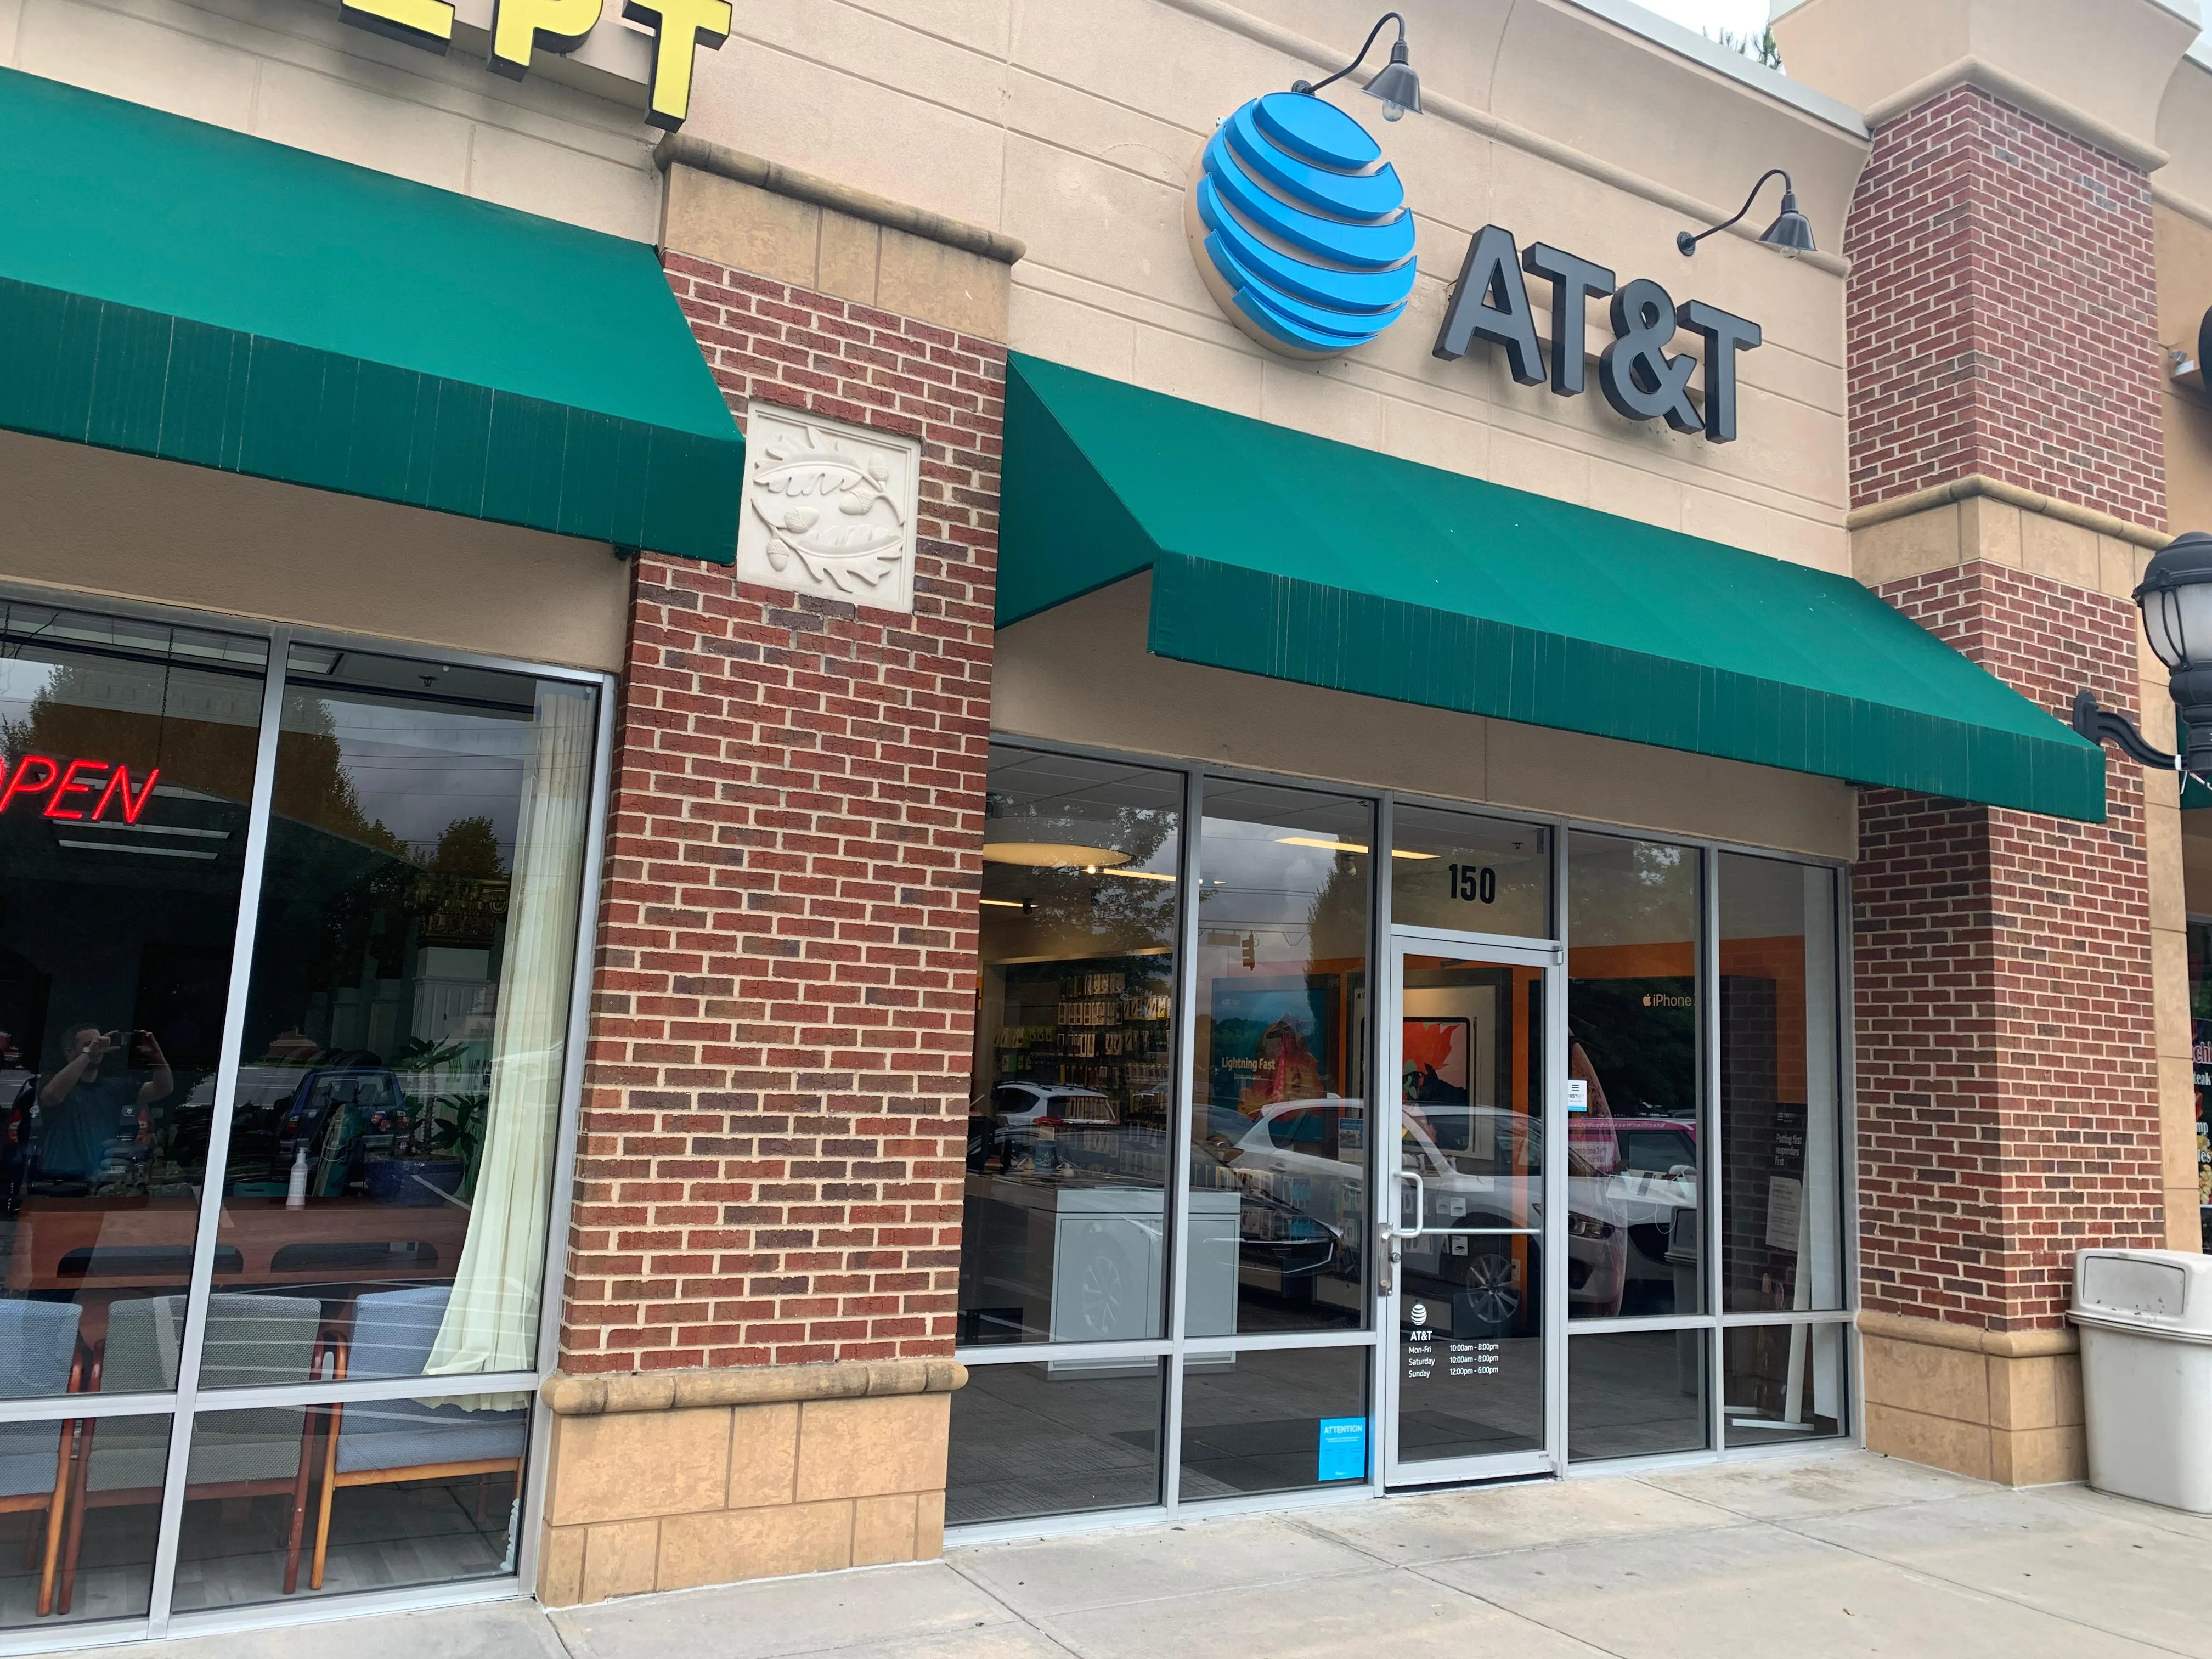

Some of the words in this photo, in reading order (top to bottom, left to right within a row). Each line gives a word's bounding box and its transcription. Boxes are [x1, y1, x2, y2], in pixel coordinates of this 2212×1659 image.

[338, 0, 732, 133] PT
[1432, 224, 1762, 444] AT&T
[0, 755, 160, 823] PEN
[1448, 864, 1496, 904] 150
[1652, 994, 1692, 1006] iPhone
[1222, 1057, 1257, 1071] Lightning
[1259, 1058, 1276, 1070] Fast
[2193, 1072, 2212, 1086] teak
[2196, 1122, 2209, 1135] mp
[1776, 1133, 1792, 1146] Putting
[1792, 1135, 1803, 1145] first
[1775, 1147, 1800, 1156] responders
[2197, 1149, 2211, 1163] les
[1774, 1156, 1785, 1166] first
[1410, 1331, 1432, 1341] AT&T
[1409, 1346, 1432, 1354] Mon-Fri
[1478, 1343, 1499, 1352] 8:00pm
[1409, 1358, 1435, 1367] Saturday
[1478, 1355, 1499, 1363] 8:00pm
[1409, 1369, 1430, 1378] Sunday
[1450, 1368, 1473, 1376] 12:00pm
[1478, 1366, 1499, 1375] 6:00pm
[1324, 1425, 1363, 1434] ATTENTION
